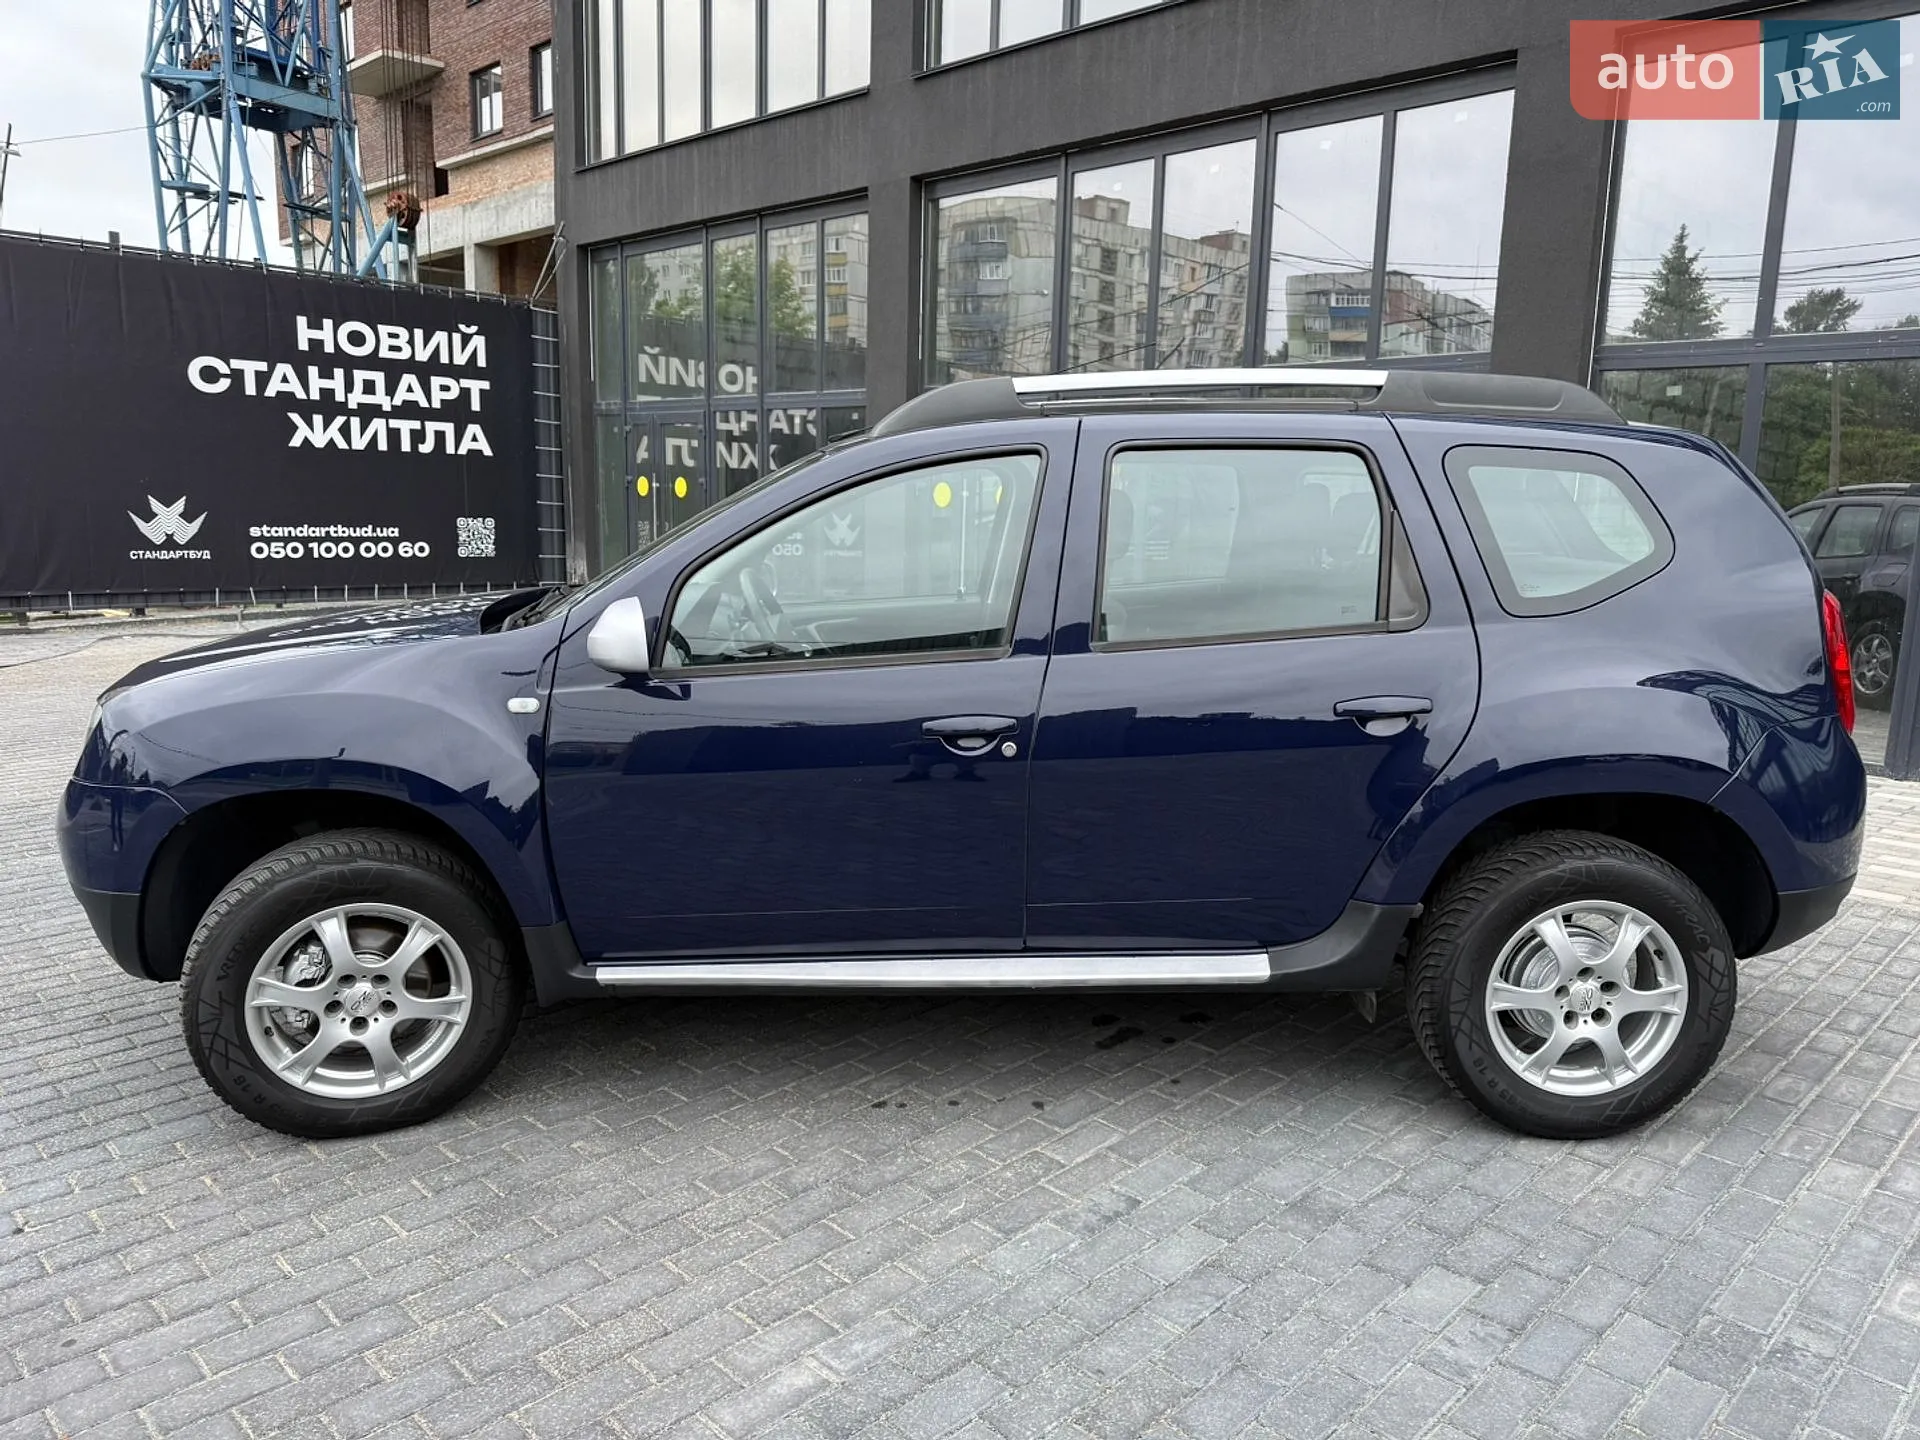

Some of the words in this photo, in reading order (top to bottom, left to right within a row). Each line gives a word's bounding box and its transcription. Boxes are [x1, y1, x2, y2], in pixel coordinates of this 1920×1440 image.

[296, 316, 487, 368] НОВИЙ
[187, 356, 491, 412] СТАНДАРТ
[287, 412, 494, 457] ЖИТЛА
[249, 524, 400, 538] standartbud.ua
[129, 550, 211, 560] СТАНДАРТБУД
[250, 541, 305, 559] 050
[308, 541, 355, 559] 100
[359, 541, 395, 559] 00
[398, 541, 431, 558] 60
